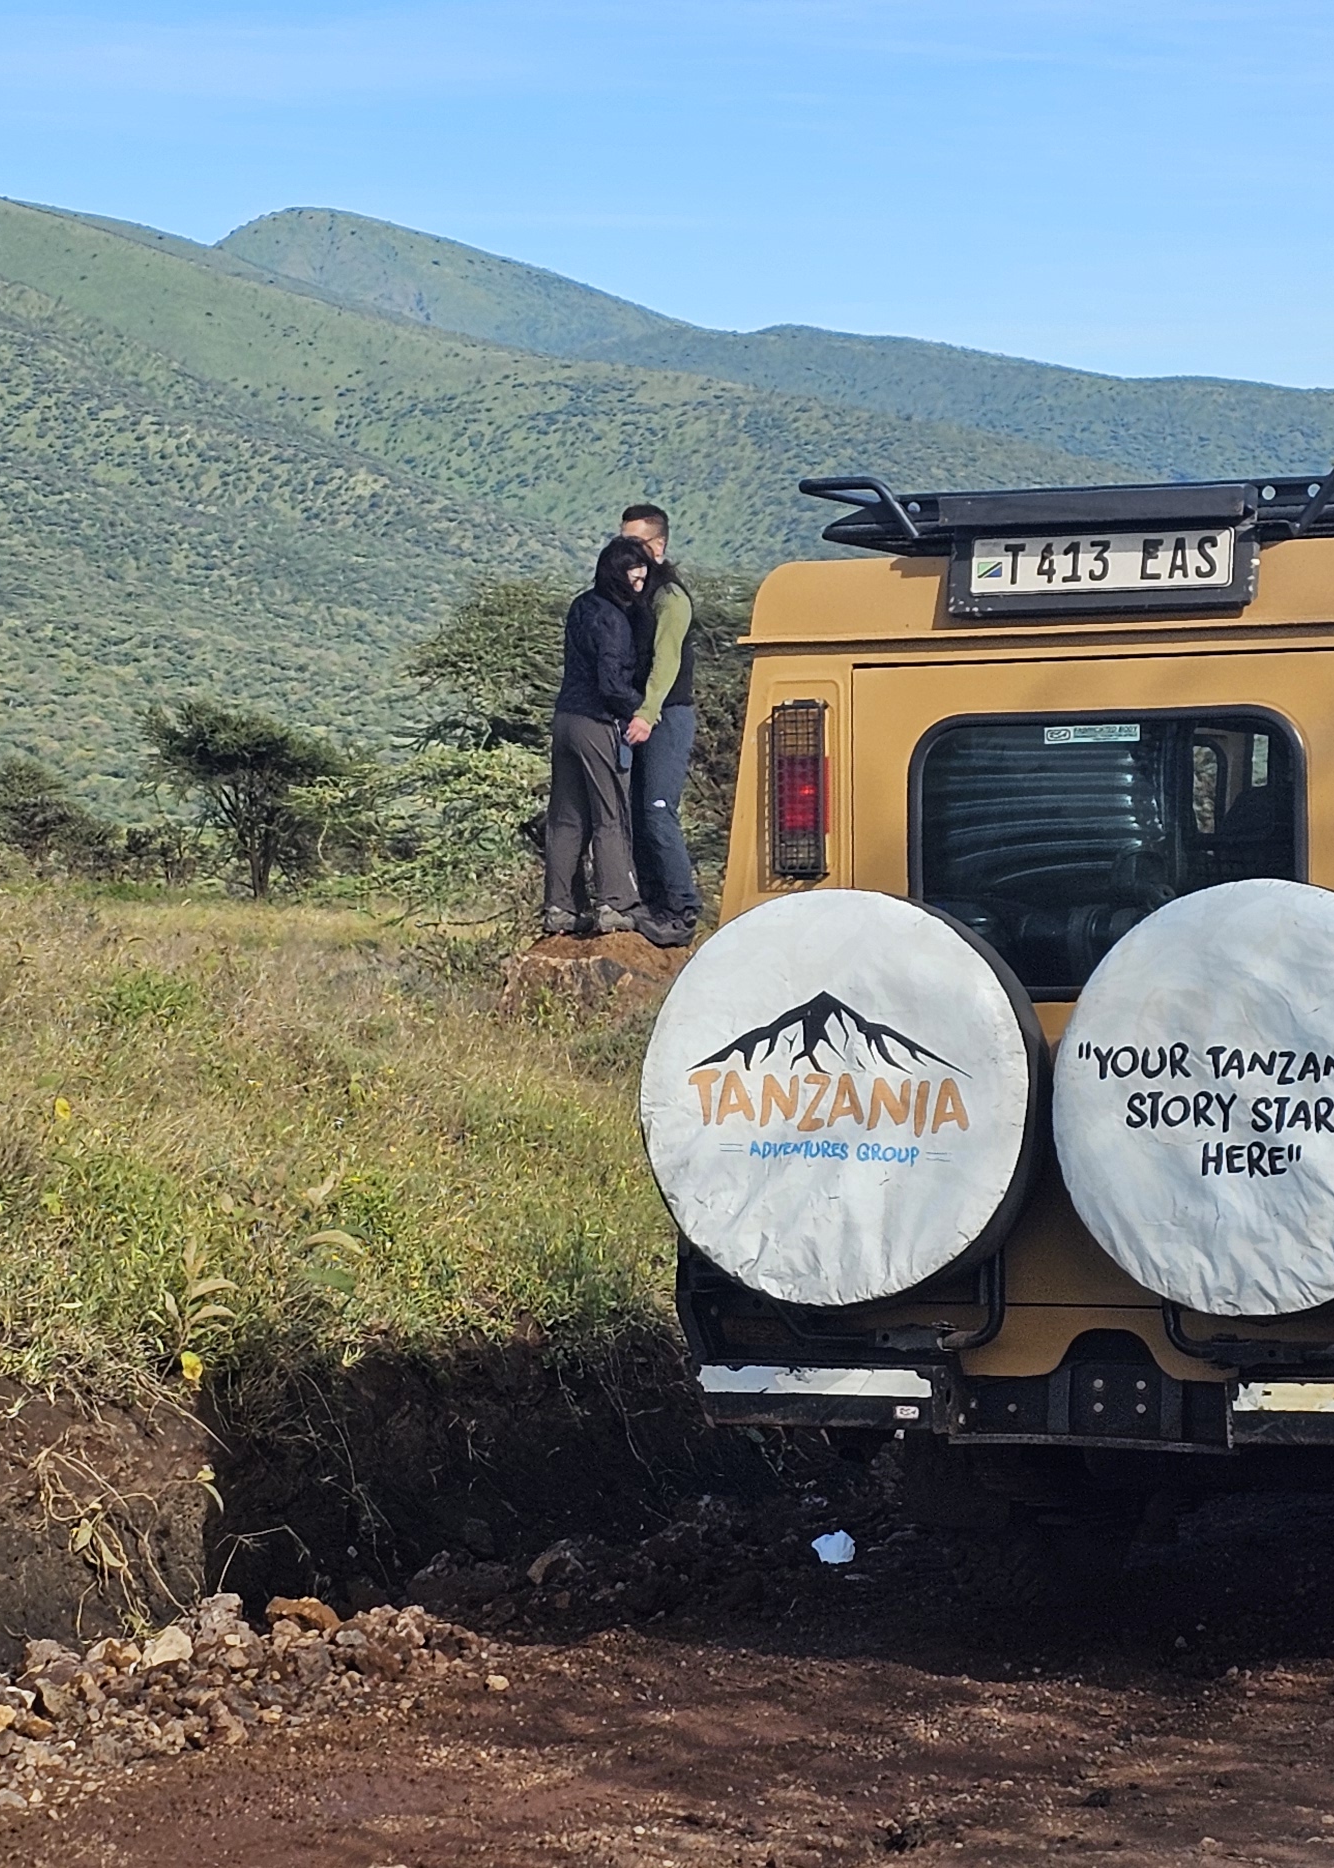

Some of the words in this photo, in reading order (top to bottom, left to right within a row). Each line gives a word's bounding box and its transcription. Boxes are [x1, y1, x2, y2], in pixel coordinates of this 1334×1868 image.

[1004, 543, 1026, 585] T
[1037, 540, 1111, 584] 413
[1140, 536, 1218, 580] EAS
[1078, 1042, 1192, 1080] "YOUR
[688, 1069, 969, 1138] TANZANIA
[1126, 1091, 1237, 1133] STORY
[750, 1140, 849, 1160] ADVENTURES
[857, 1143, 920, 1167] GROUP
[1202, 1141, 1302, 1178] HERE"
